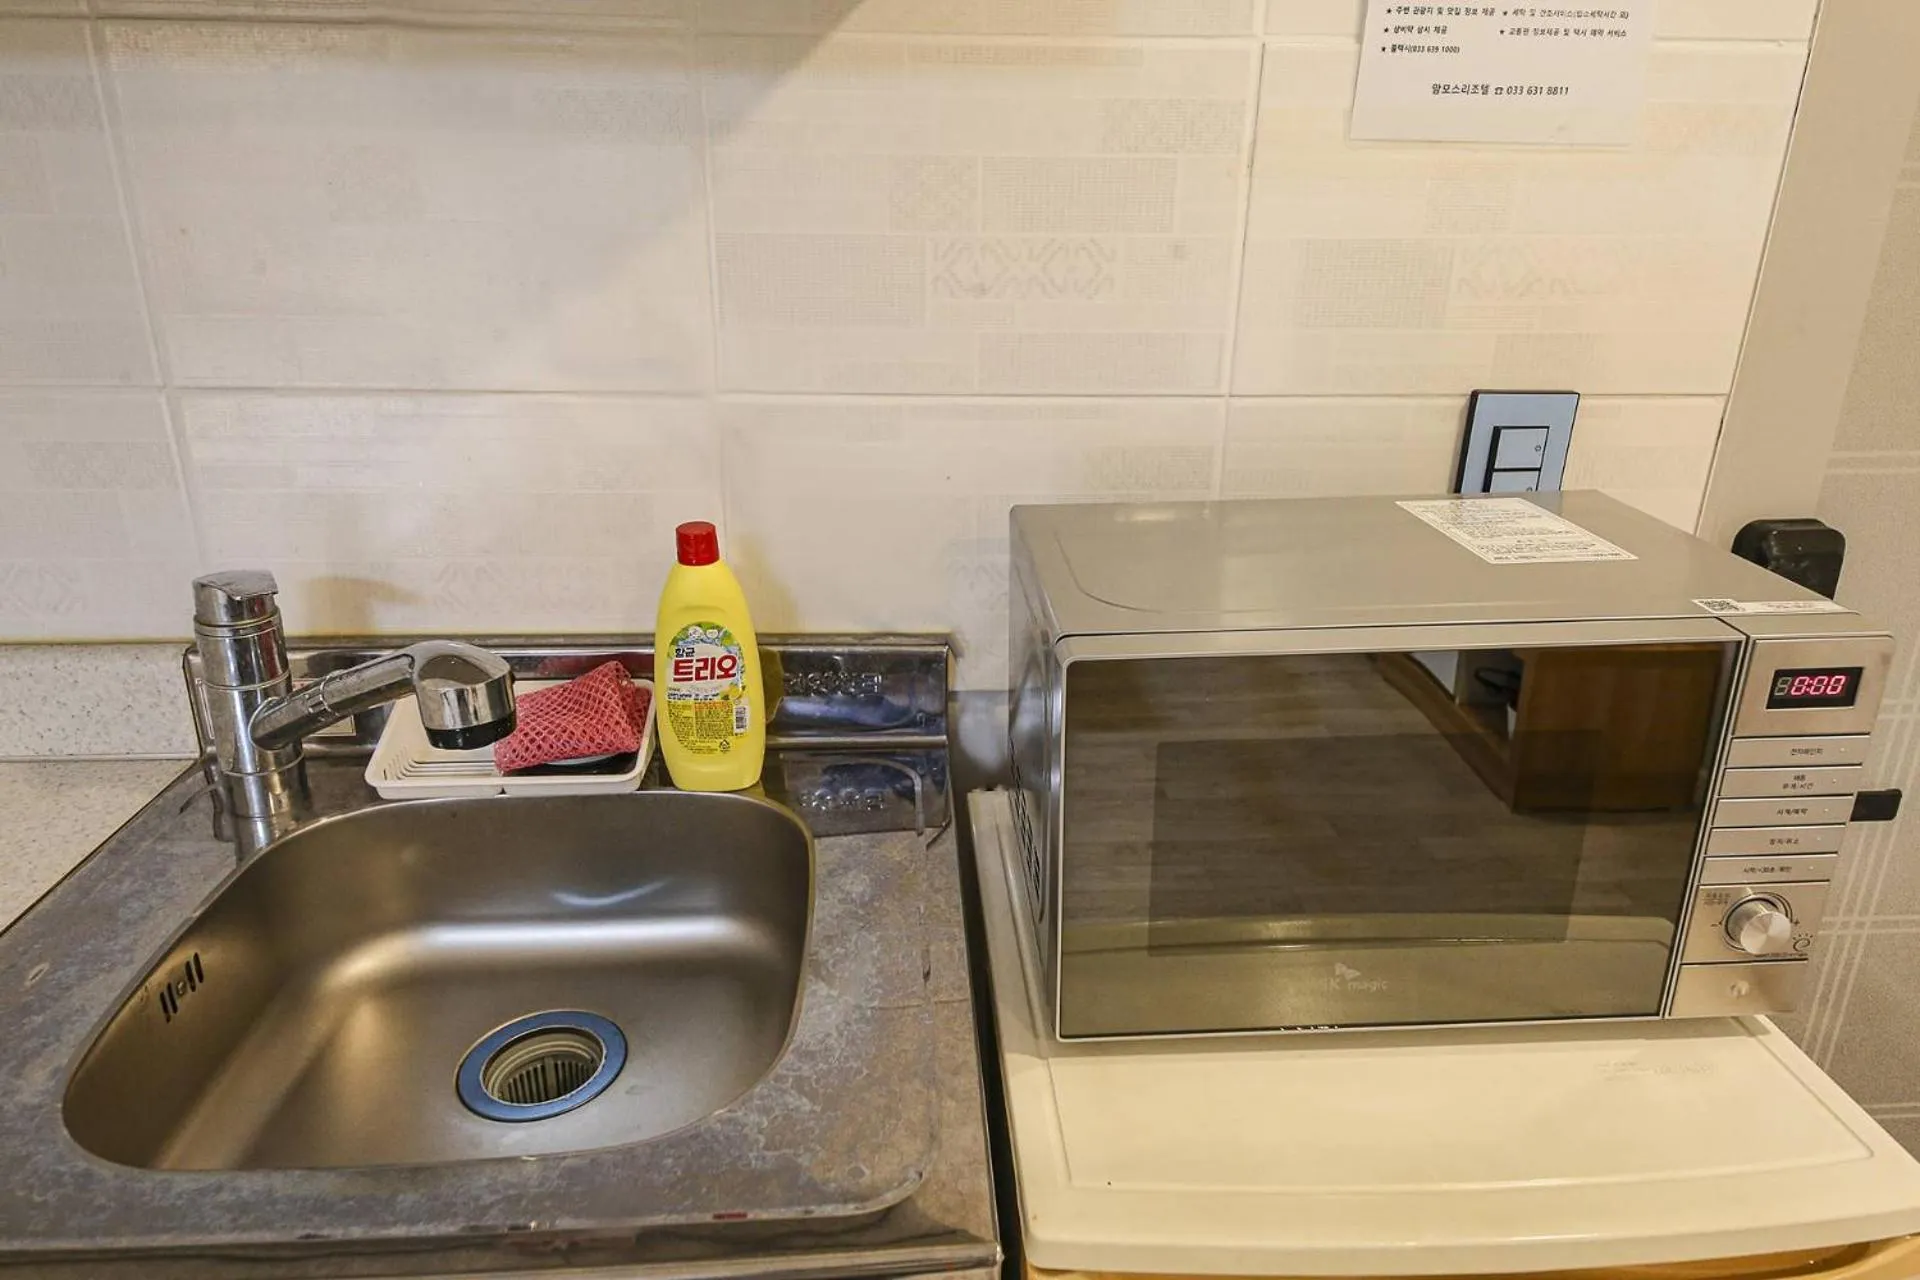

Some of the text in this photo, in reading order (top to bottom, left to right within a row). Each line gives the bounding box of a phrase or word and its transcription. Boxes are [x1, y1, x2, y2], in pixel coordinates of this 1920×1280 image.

[1413, 6, 1433, 15] 관광지
[1464, 7, 1478, 16] 정보
[1482, 7, 1495, 16] 제공
[1434, 25, 1448, 34] 제공
[1506, 85, 1524, 95] 033
[1526, 86, 1543, 95] 631
[1546, 86, 1569, 95] 8811
[673, 654, 738, 682] 트리오
[1790, 675, 1847, 695] 0:00
